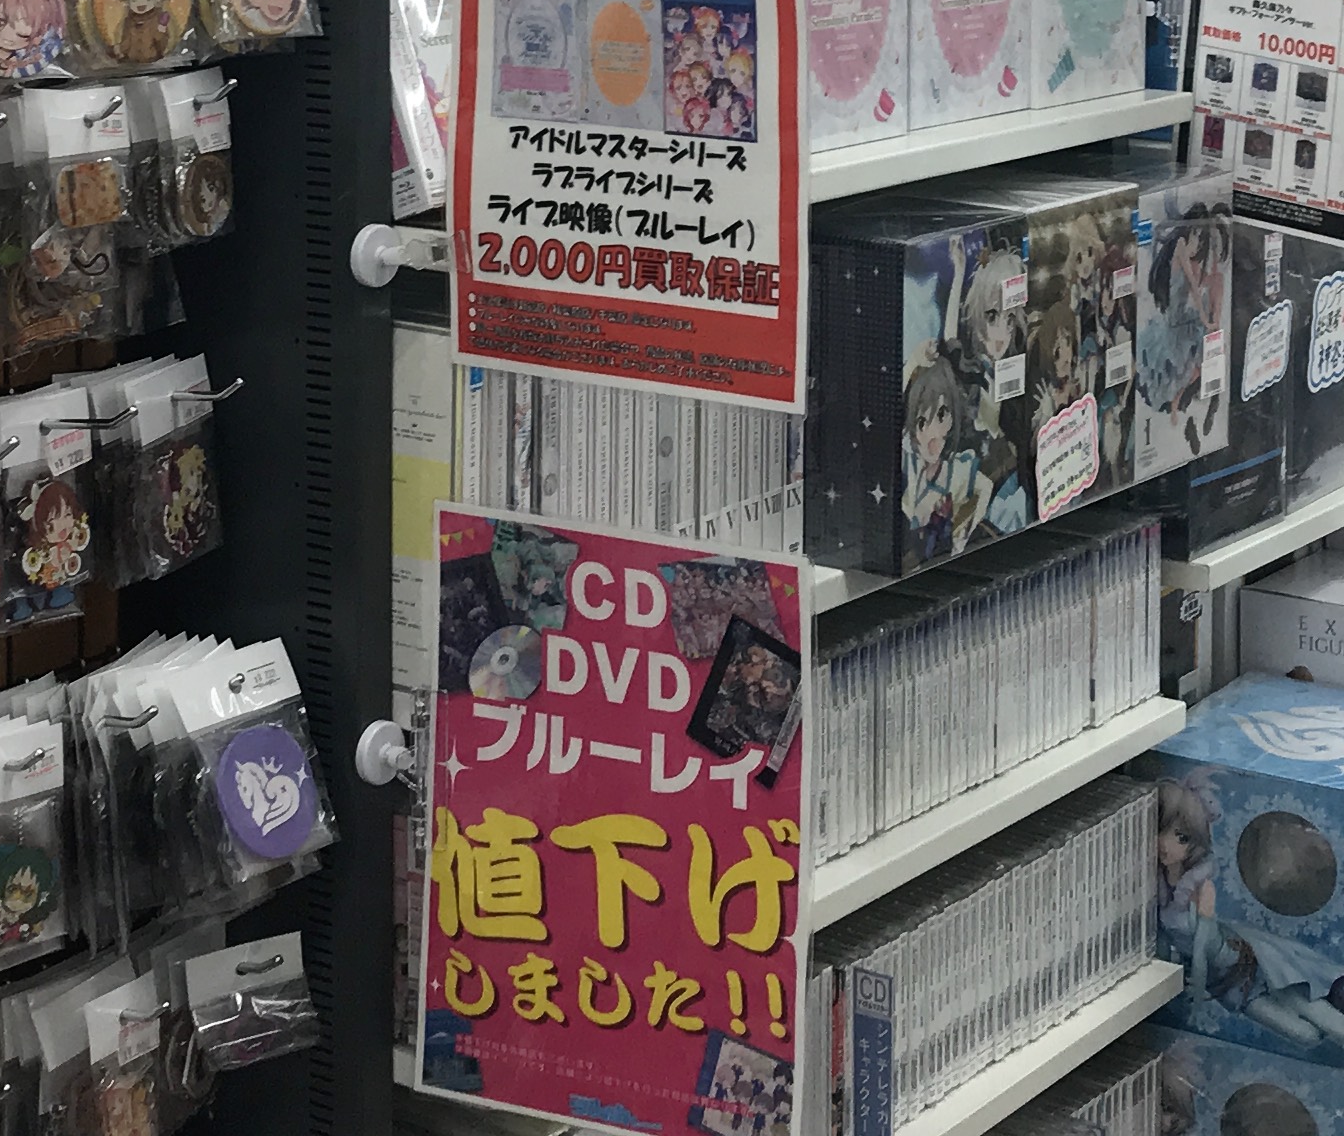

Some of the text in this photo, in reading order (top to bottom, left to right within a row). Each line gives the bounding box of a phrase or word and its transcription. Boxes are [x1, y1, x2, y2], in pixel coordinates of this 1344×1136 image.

[1258, 31, 1336, 65] 10,000円
[509, 124, 748, 172] アイドルマスターシリーズ
[532, 163, 713, 204] ラブライブシリーズ
[478, 231, 781, 306] 2,000円買取保証
[571, 561, 668, 629] CD
[546, 634, 691, 714] DVD
[472, 702, 764, 810] ブルーレイ
[431, 807, 801, 953] 値下げ
[444, 948, 788, 1040] しました!!
[859, 975, 887, 1004] CD
